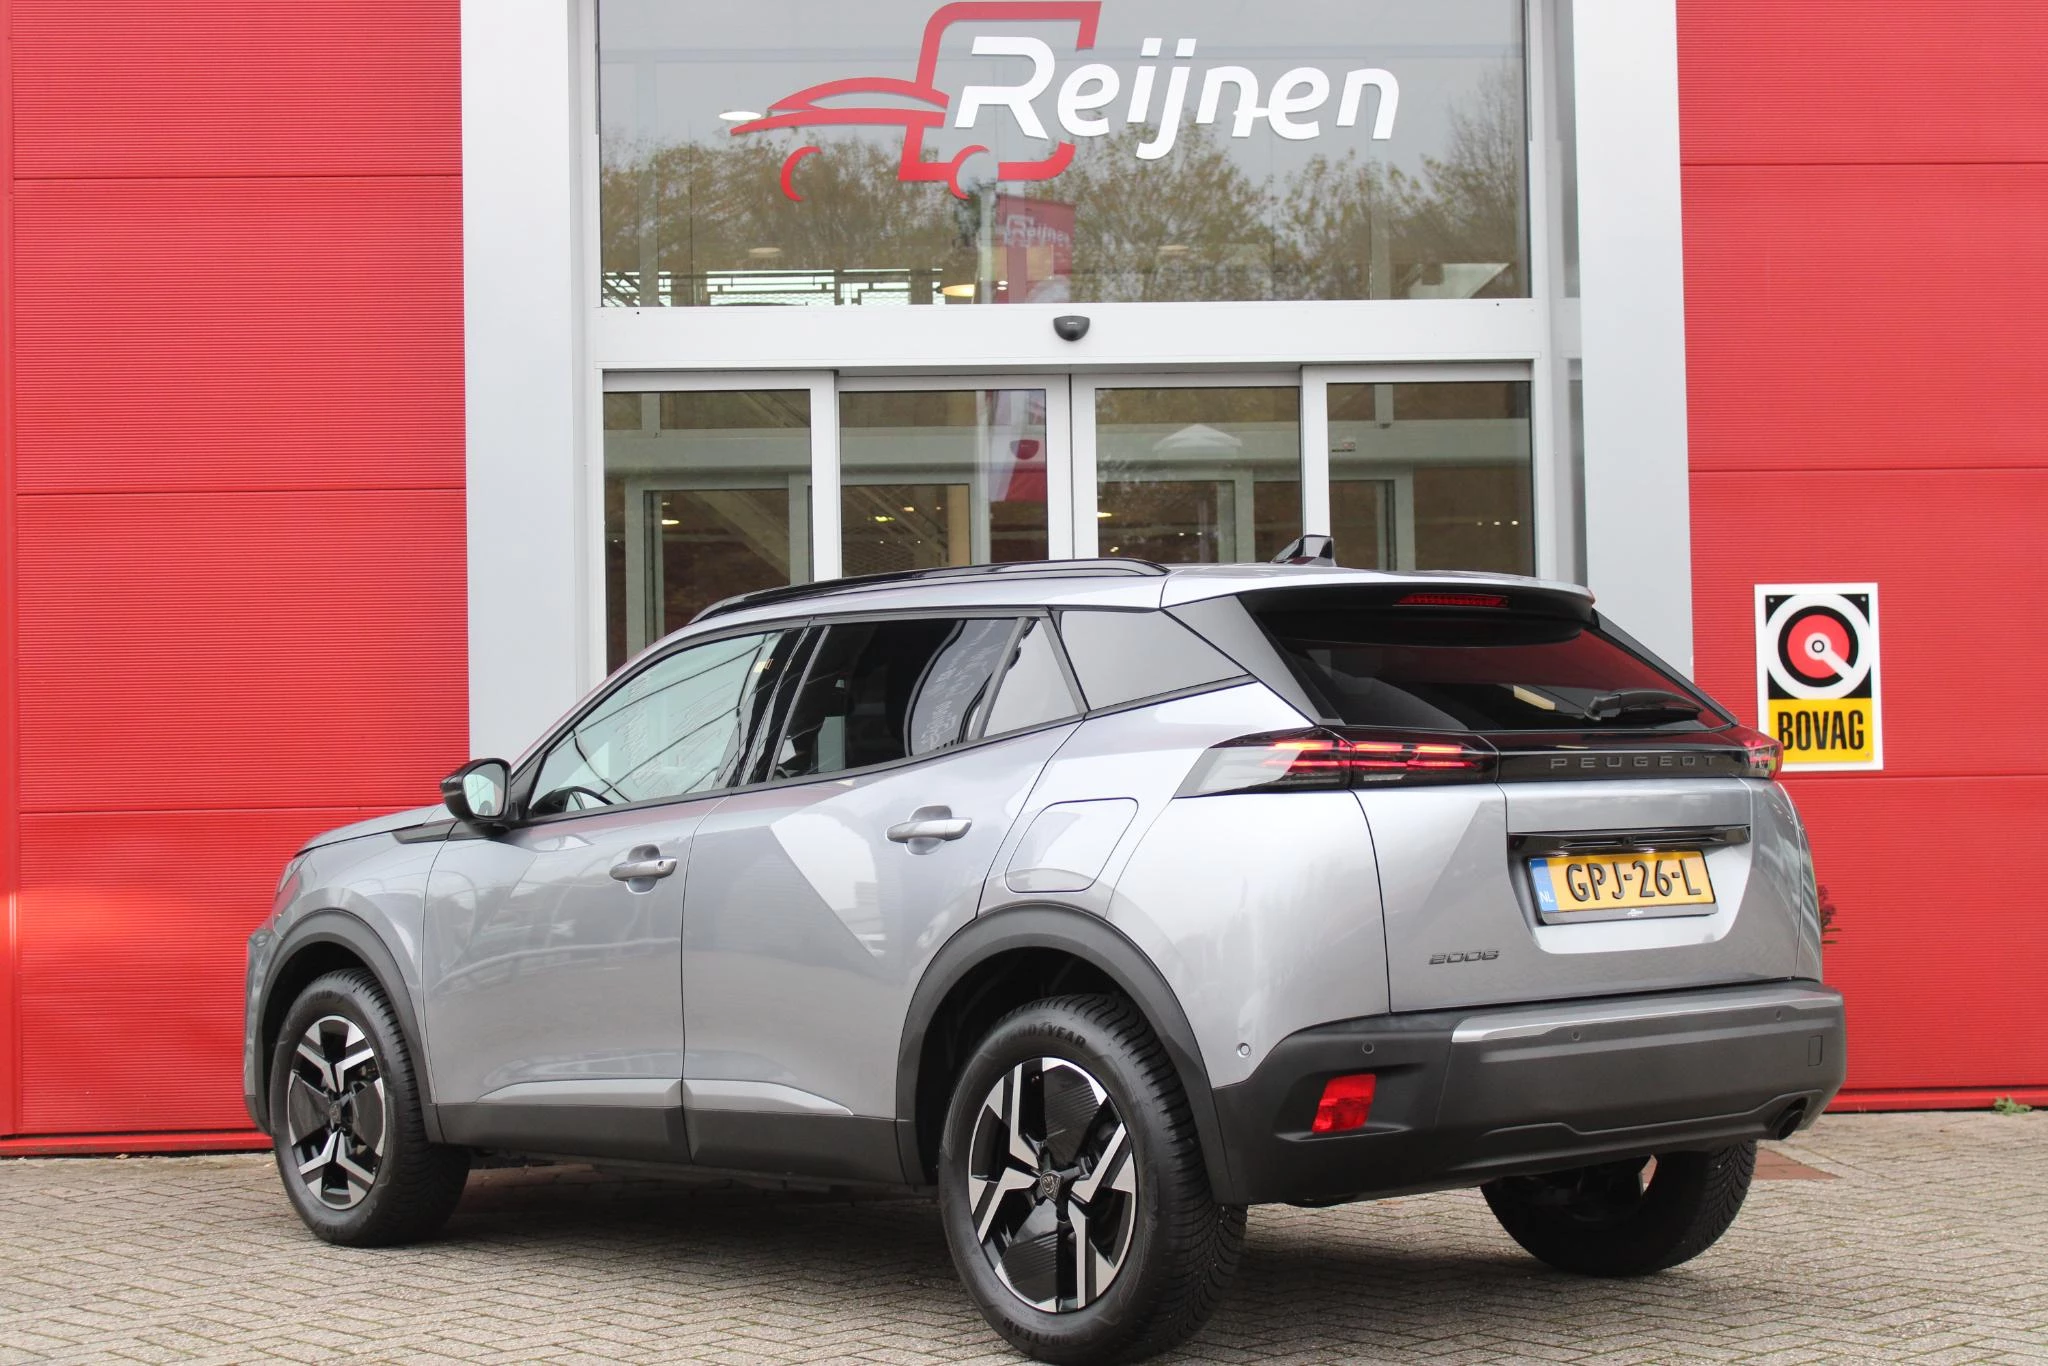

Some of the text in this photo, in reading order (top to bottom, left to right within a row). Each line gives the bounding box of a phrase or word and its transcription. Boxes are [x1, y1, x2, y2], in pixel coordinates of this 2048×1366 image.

[954, 37, 1399, 160] Reijnen
[1777, 710, 1864, 751] BOVAG
[1551, 755, 1716, 769] PEUGEOT
[1539, 889, 1554, 904] NL
[1566, 859, 1702, 902] GPJ-26-L
